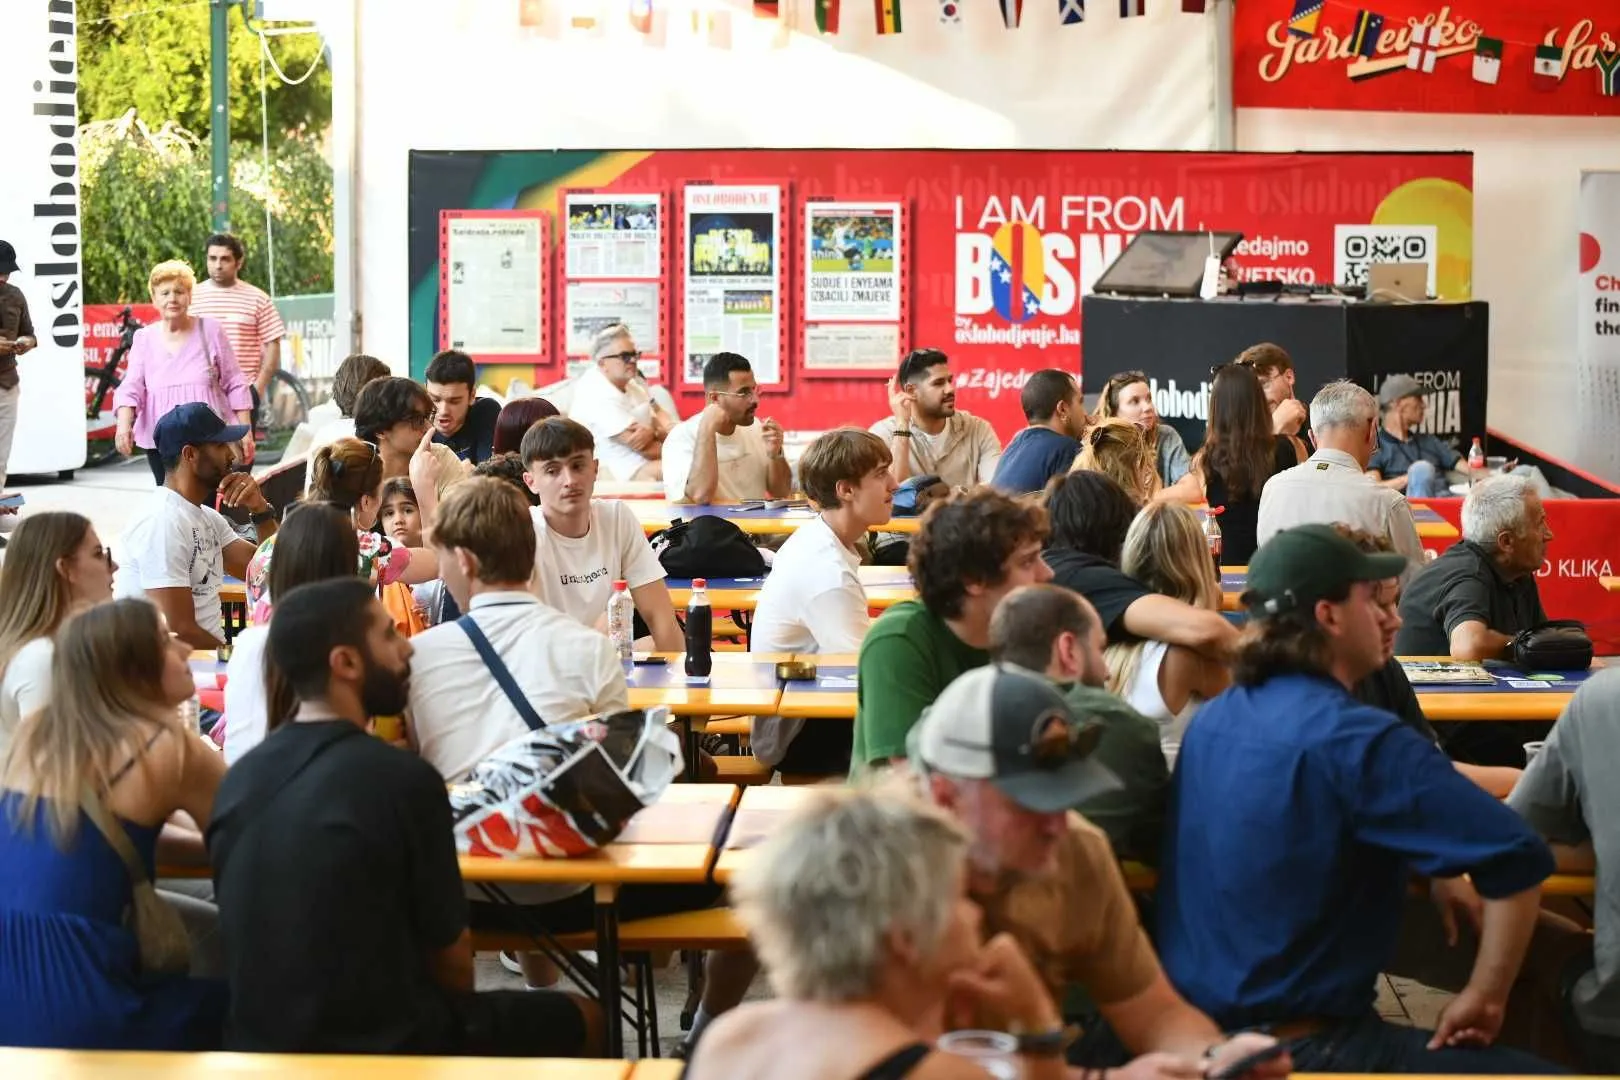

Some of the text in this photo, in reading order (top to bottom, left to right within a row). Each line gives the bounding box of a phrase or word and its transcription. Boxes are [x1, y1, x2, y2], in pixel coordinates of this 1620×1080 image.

[954, 194, 1185, 231] I AM FROM
[1233, 235, 1310, 260] edajmo
[851, 277, 893, 289] ENYEAMA
[955, 220, 1138, 323] BOSN
[852, 291, 892, 302] ZMAJEVE
[955, 323, 1080, 349] oslobodjenje.ba
[1414, 370, 1461, 391] FROM
[1149, 378, 1212, 421] lobod
[1409, 391, 1461, 434] NIA
[1532, 559, 1613, 578] D KLIKA
